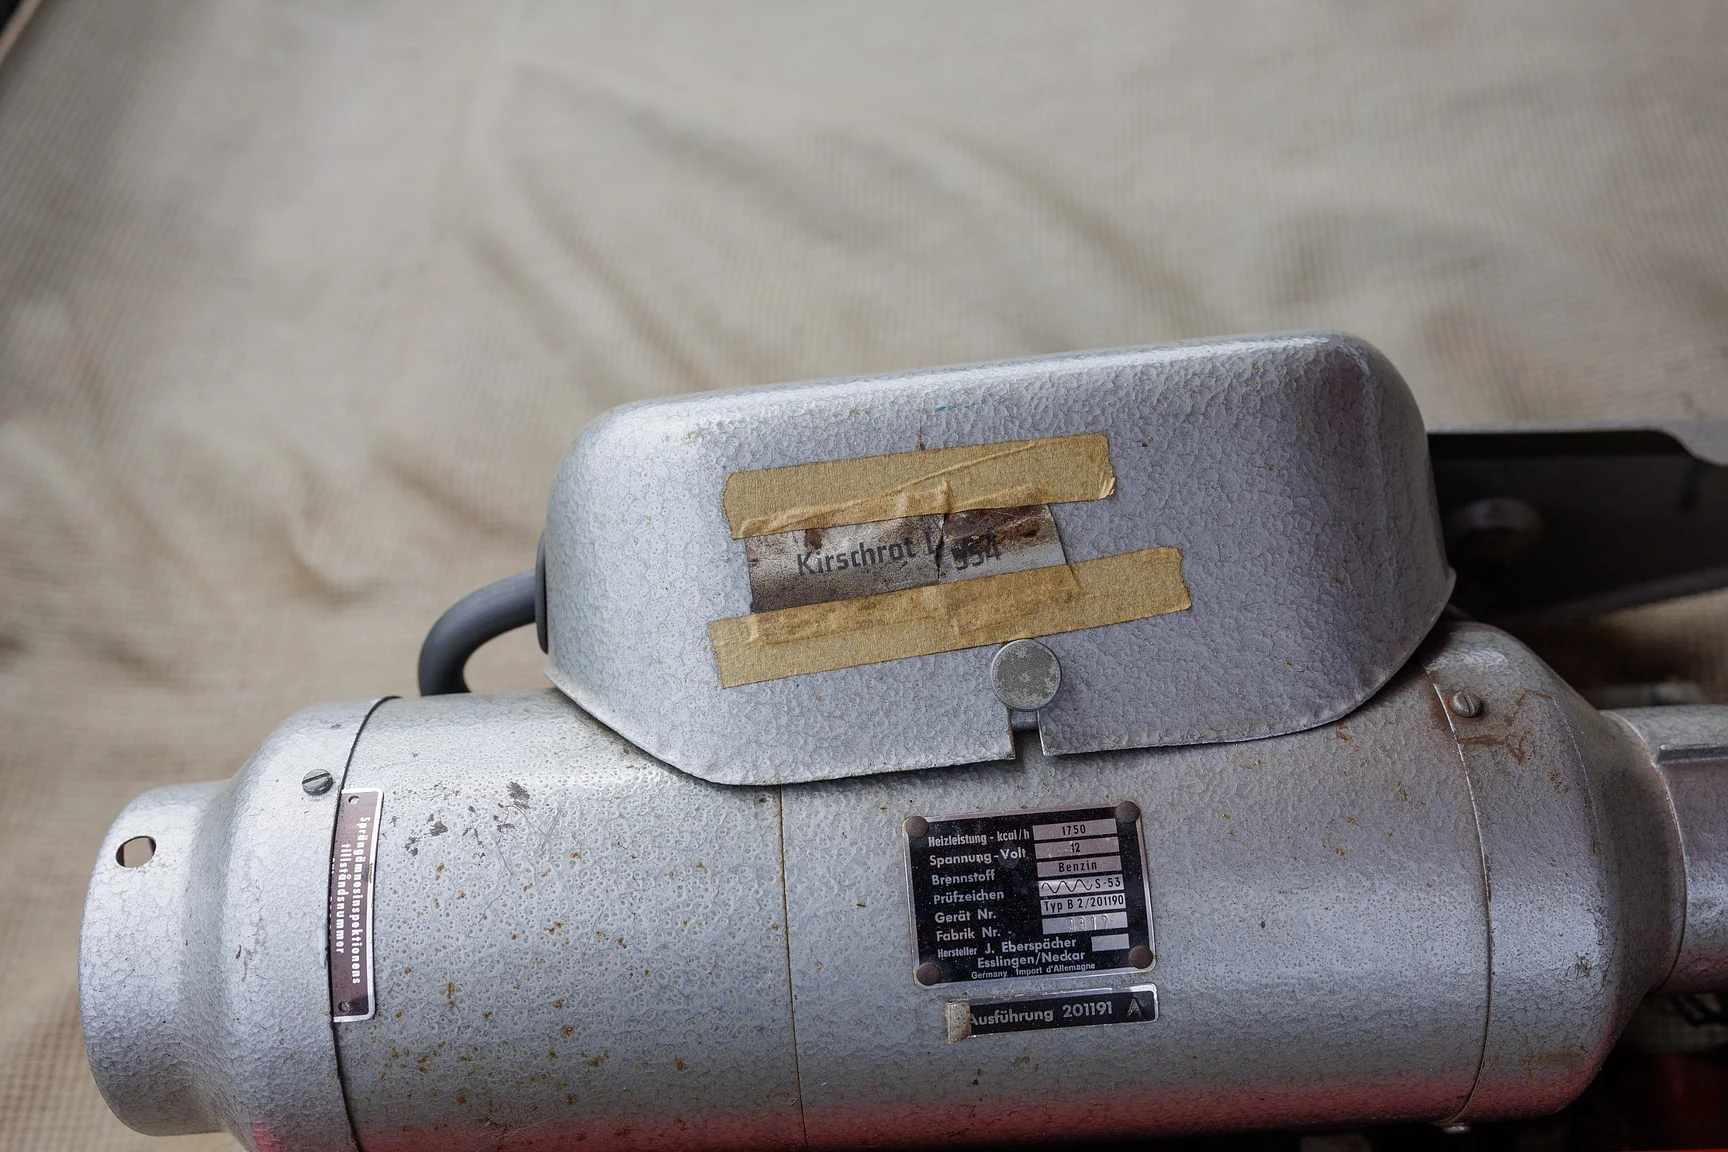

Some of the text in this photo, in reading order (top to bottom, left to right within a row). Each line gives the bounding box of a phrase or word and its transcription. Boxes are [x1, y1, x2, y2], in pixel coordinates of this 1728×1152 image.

[797, 537, 916, 577] Kirschrot
[928, 834, 987, 848] Heizleistung
[1062, 825, 1086, 836] 1750
[929, 853, 992, 868] Spannung
[1000, 847, 1026, 860] Volt
[1070, 842, 1080, 853] 12
[931, 860, 1097, 886] Brennstoff Benzin
[336, 843, 352, 953] tillståndsnummer
[349, 816, 371, 984] Sprängämnesinspektionens
[934, 889, 1004, 904] Prüfzeichen
[935, 910, 970, 923] Gerät
[977, 908, 996, 920] Nr.
[1044, 901, 1062, 913] Typ
[936, 928, 975, 941] Fabrik
[982, 926, 1000, 938] Nr.
[938, 937, 1077, 958] Hersteller J. Eberspächer
[977, 950, 1085, 968] Esslingen/Neckar
[1016, 967, 1042, 976] Import
[1046, 963, 1095, 974] d'Allemagne
[971, 997, 1143, 1025] Ausführung 201191 A
